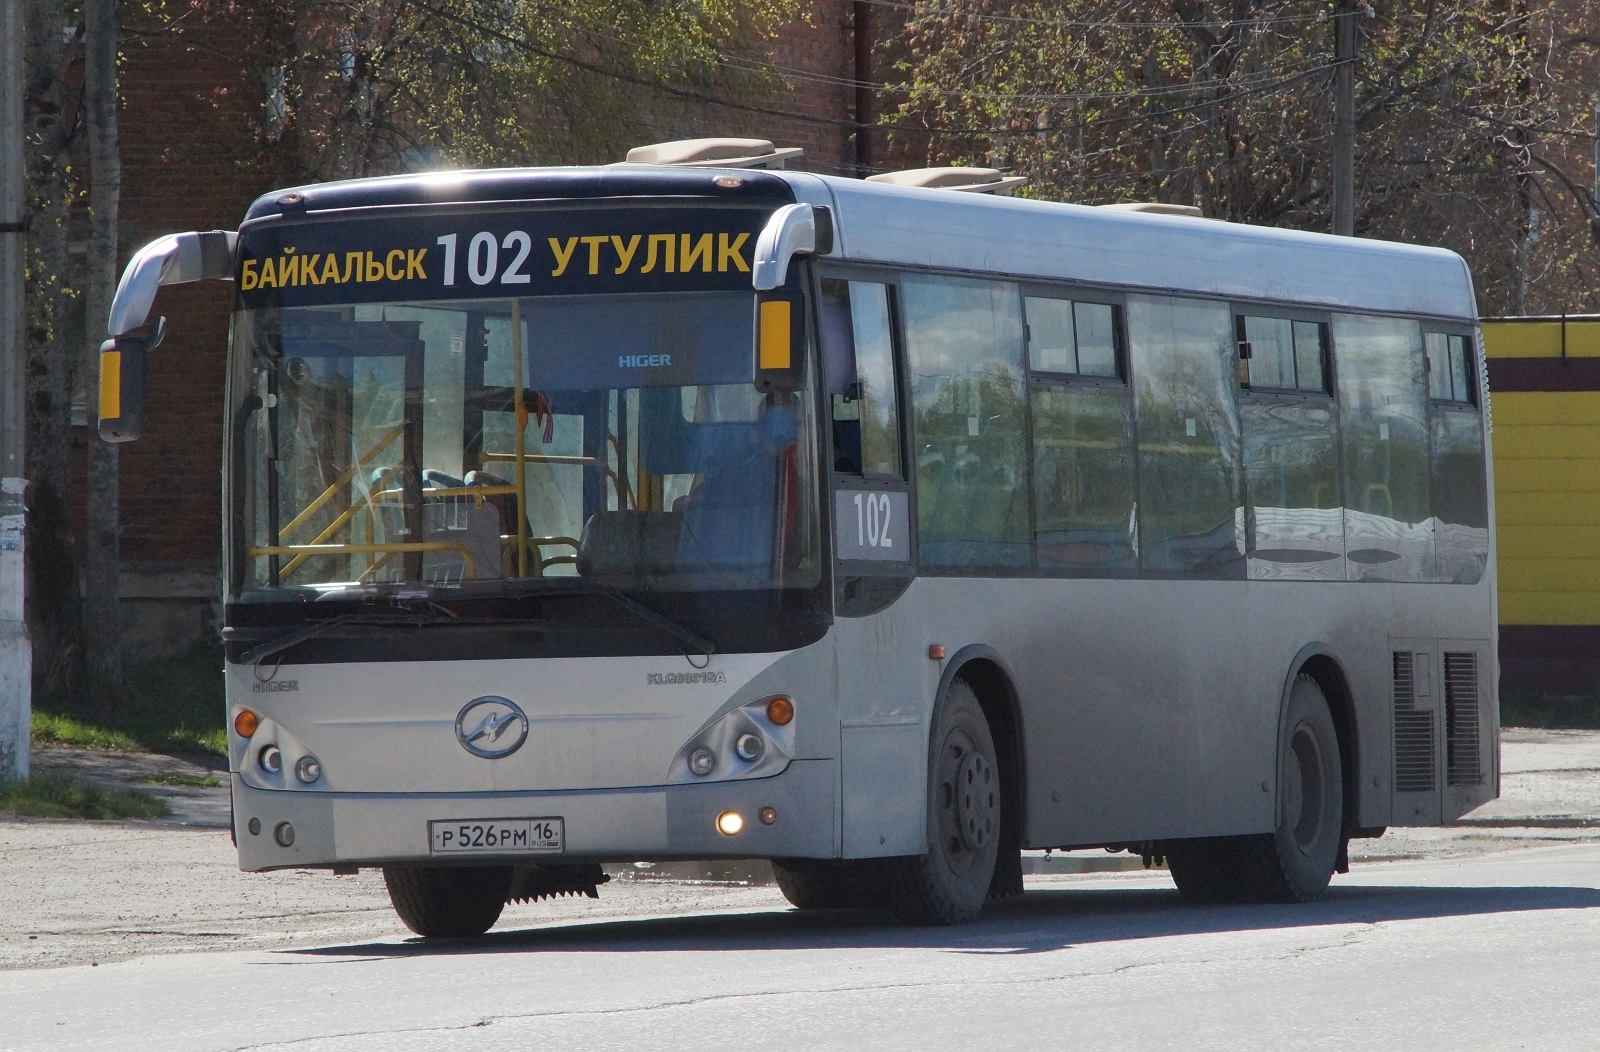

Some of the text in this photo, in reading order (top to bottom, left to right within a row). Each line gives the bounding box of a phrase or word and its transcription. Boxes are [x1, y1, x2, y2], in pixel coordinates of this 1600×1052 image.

[241, 230, 751, 291] БАЙКАЛЬСК 102 УТУЛИК
[618, 354, 672, 368] HIGER
[854, 492, 893, 548] 102
[252, 680, 300, 693] HIGER
[533, 822, 553, 840] 16
